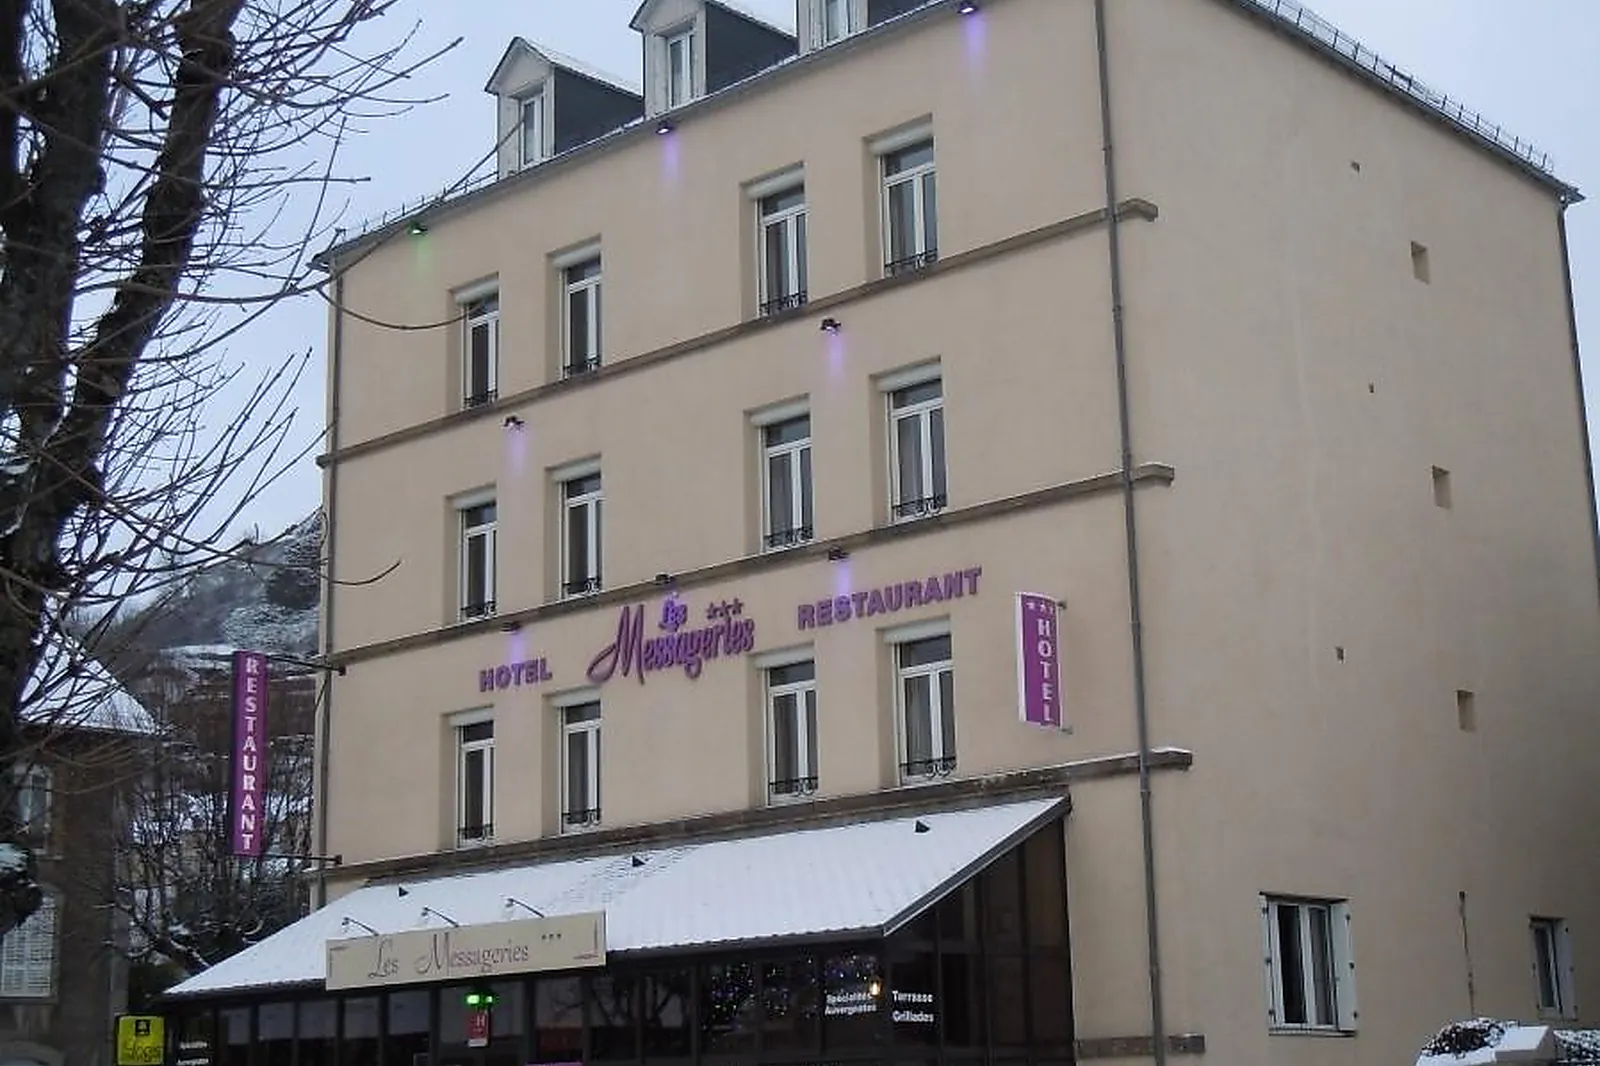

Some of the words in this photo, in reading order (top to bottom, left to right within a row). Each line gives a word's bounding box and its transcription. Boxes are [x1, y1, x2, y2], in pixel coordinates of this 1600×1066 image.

[797, 566, 983, 631] RESTAURANT
[478, 658, 553, 692] HOTEL
[586, 603, 755, 686] Messageries
[1037, 617, 1055, 724] HOTEL
[241, 657, 260, 850] RESTAURANT
[367, 938, 400, 979] Les
[416, 930, 530, 975] Messageries
